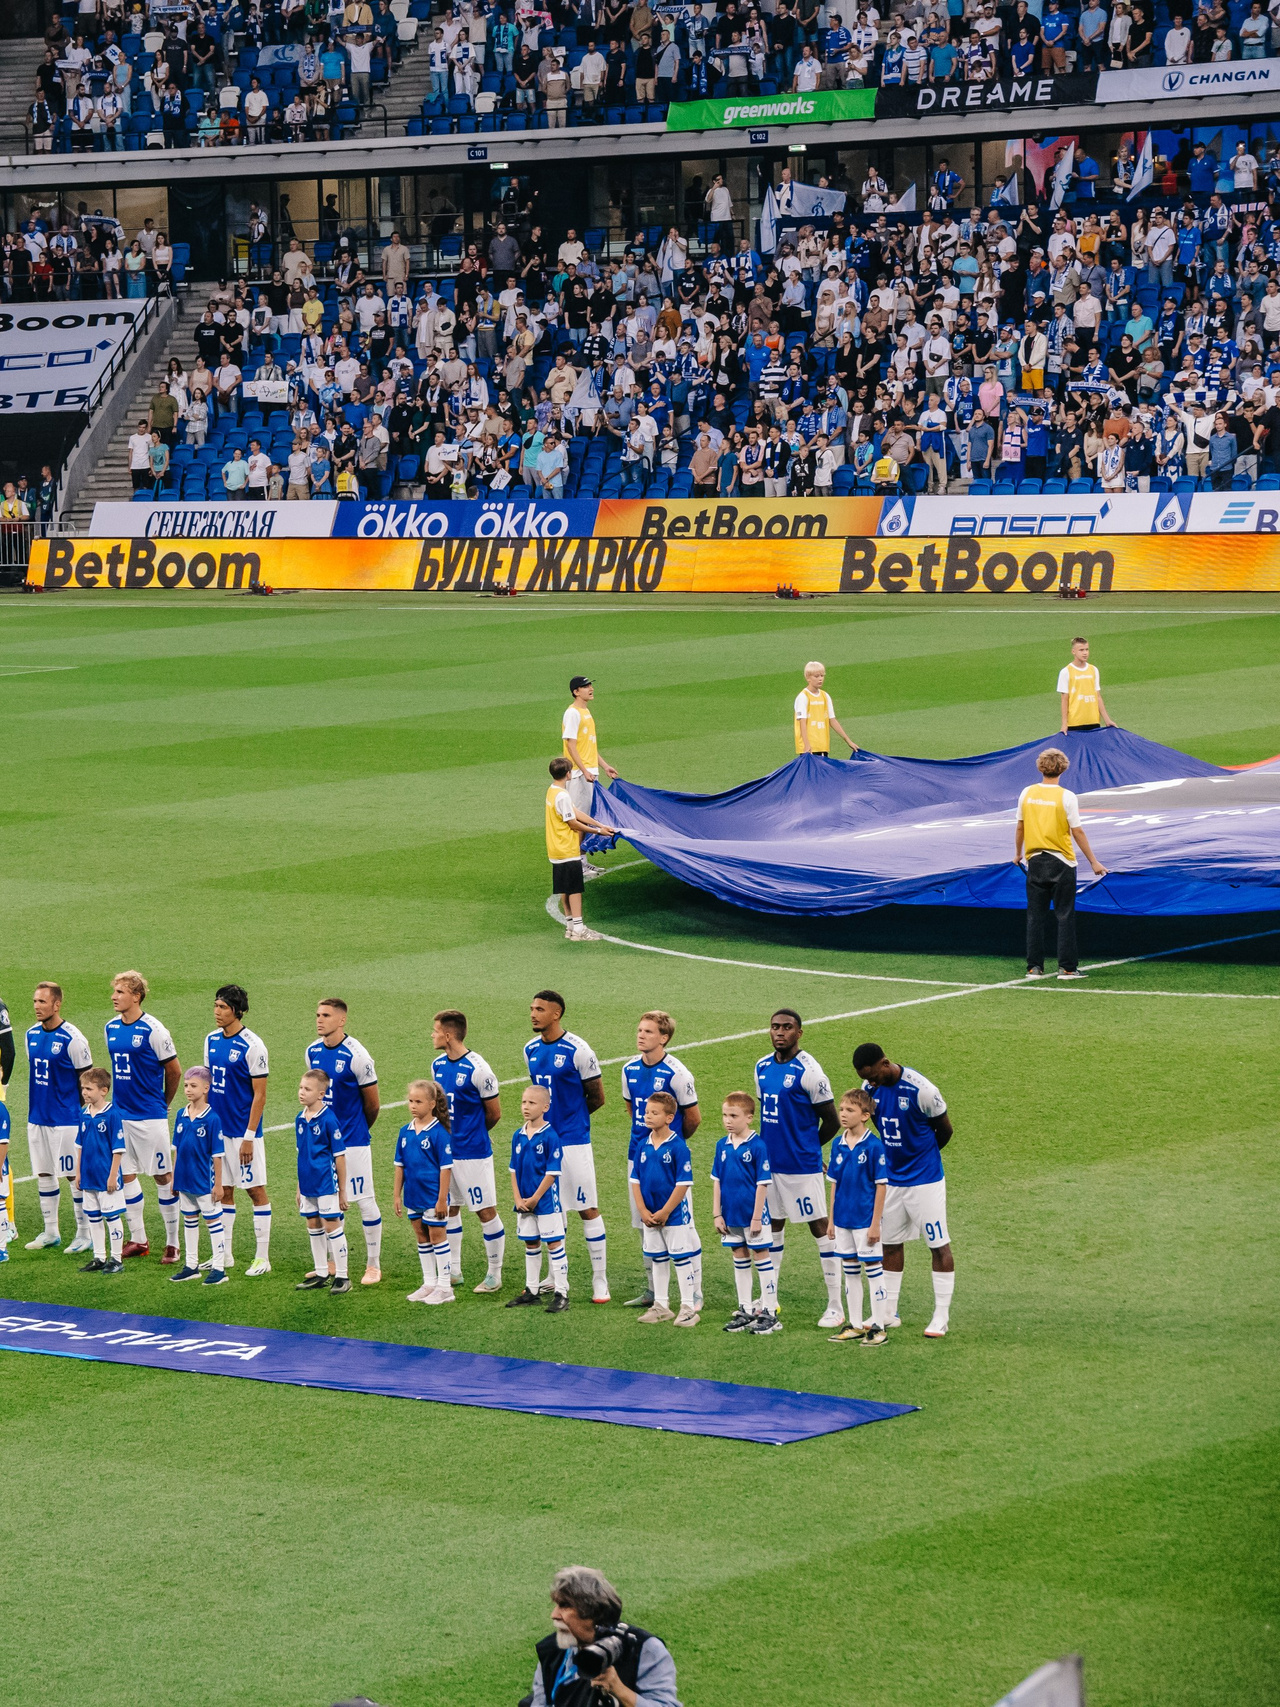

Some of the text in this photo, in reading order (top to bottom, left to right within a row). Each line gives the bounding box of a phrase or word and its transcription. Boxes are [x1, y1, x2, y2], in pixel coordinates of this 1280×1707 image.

[1188, 69, 1270, 85] CHANGAN
[916, 79, 1055, 110] DREAME
[724, 97, 815, 124] greenworks
[145, 510, 277, 537] СЕНЕЖСКАЯ
[640, 505, 828, 538] BetBoom
[44, 538, 261, 588] BetBoom
[414, 539, 668, 592] БУДЕТ ЖАРКО
[839, 537, 1115, 592] BetBoom
[59, 1154, 74, 1172] 10
[155, 1152, 166, 1170] 2
[350, 1176, 364, 1195] 17
[468, 1186, 483, 1205] 19
[576, 1185, 587, 1203] 4
[796, 1196, 814, 1216] 16
[925, 1220, 943, 1241] 91
